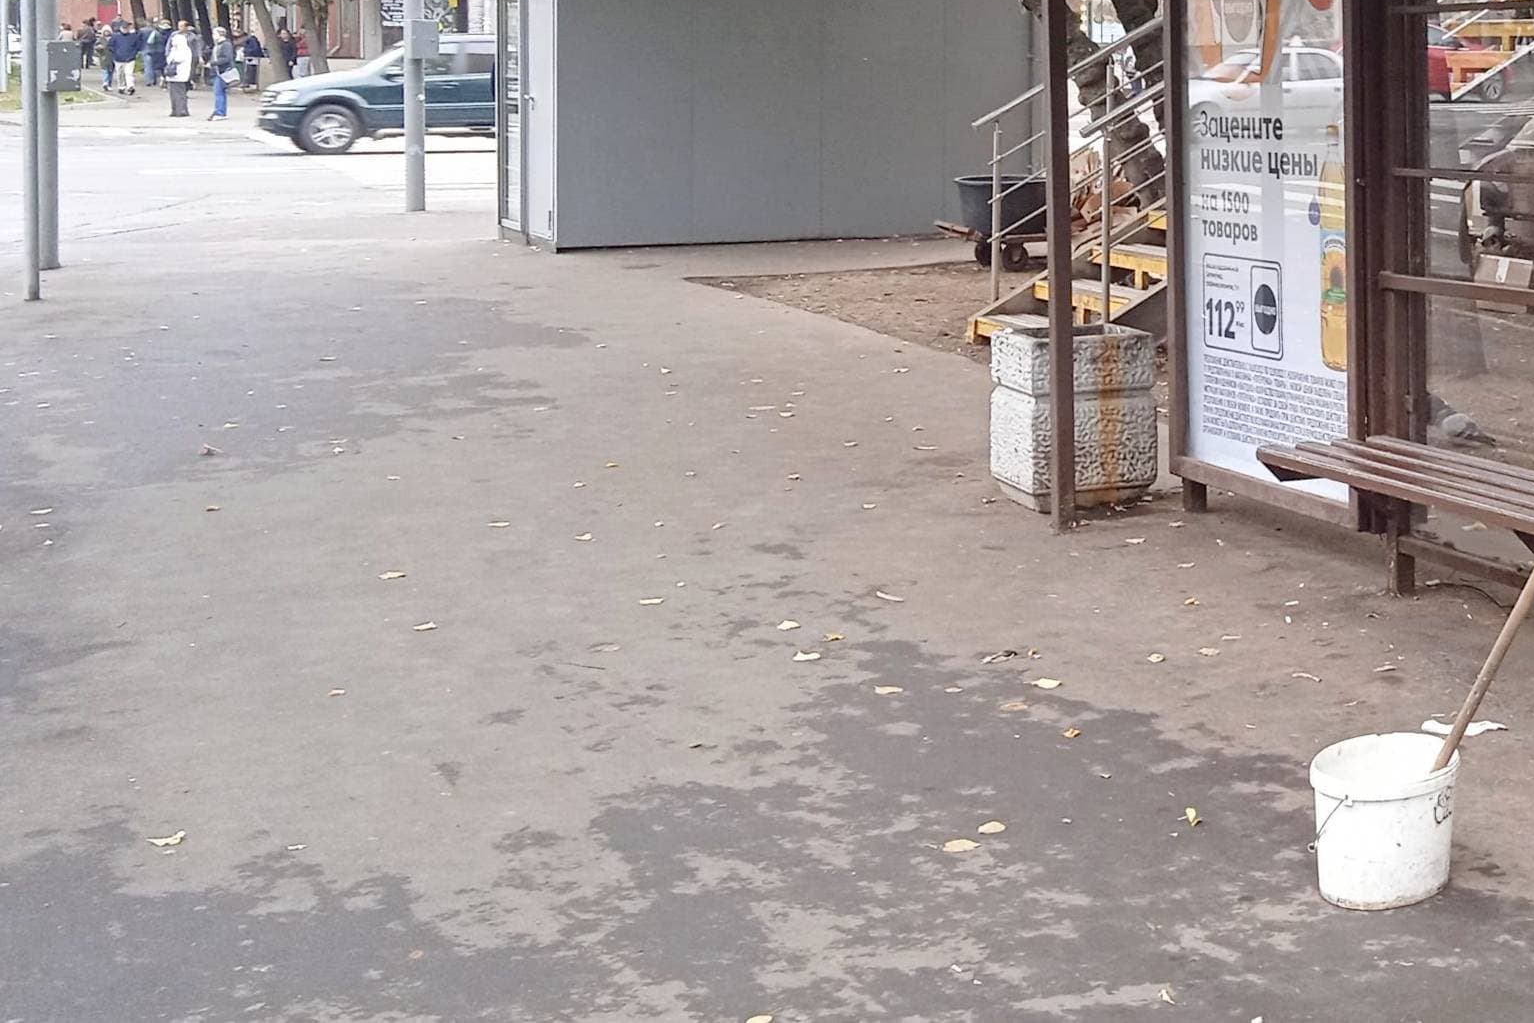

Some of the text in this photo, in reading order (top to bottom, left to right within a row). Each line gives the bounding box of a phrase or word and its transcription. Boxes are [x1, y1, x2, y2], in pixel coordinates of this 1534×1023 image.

[1200, 110, 1283, 143] Зацените
[1201, 148, 1318, 179] низкие цены
[1201, 190, 1250, 214] на 1500
[1202, 219, 1258, 245] товаров
[1206, 298, 1235, 339] 112
